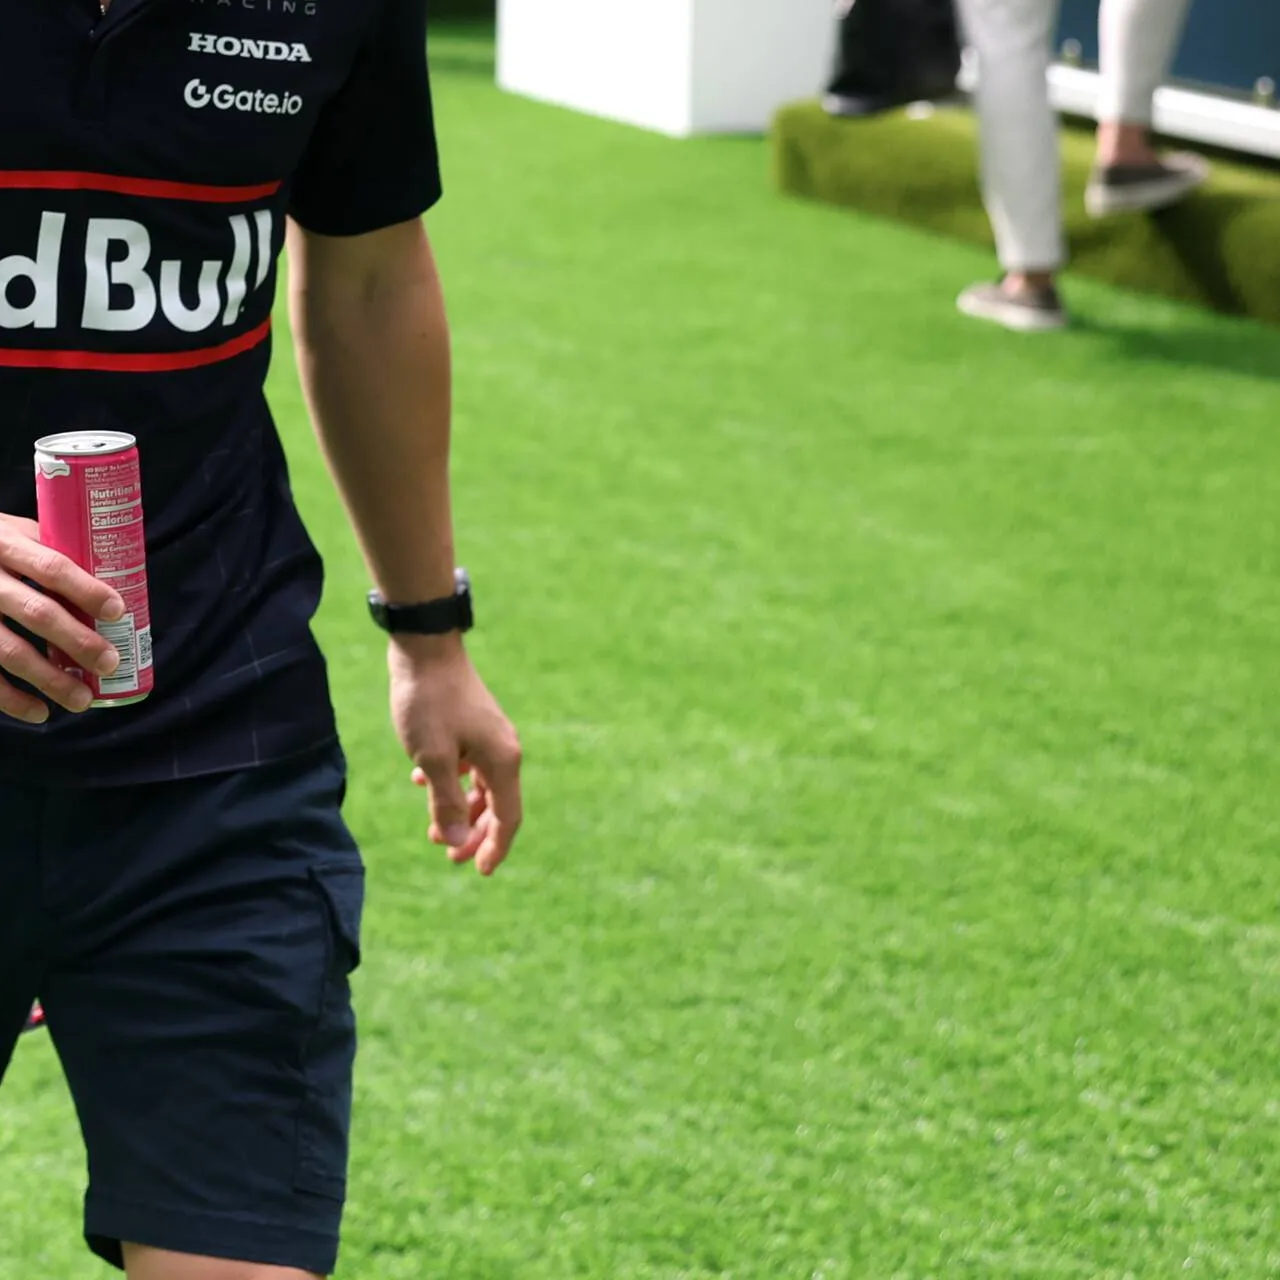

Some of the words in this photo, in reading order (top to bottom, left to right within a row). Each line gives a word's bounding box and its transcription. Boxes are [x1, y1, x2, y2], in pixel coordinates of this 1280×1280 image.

[187, 33, 312, 62] HONDA
[212, 84, 303, 115] Gate.io
[81, 209, 273, 333] Bull
[90, 486, 133, 499] Nutrition
[91, 515, 133, 525] Calories
